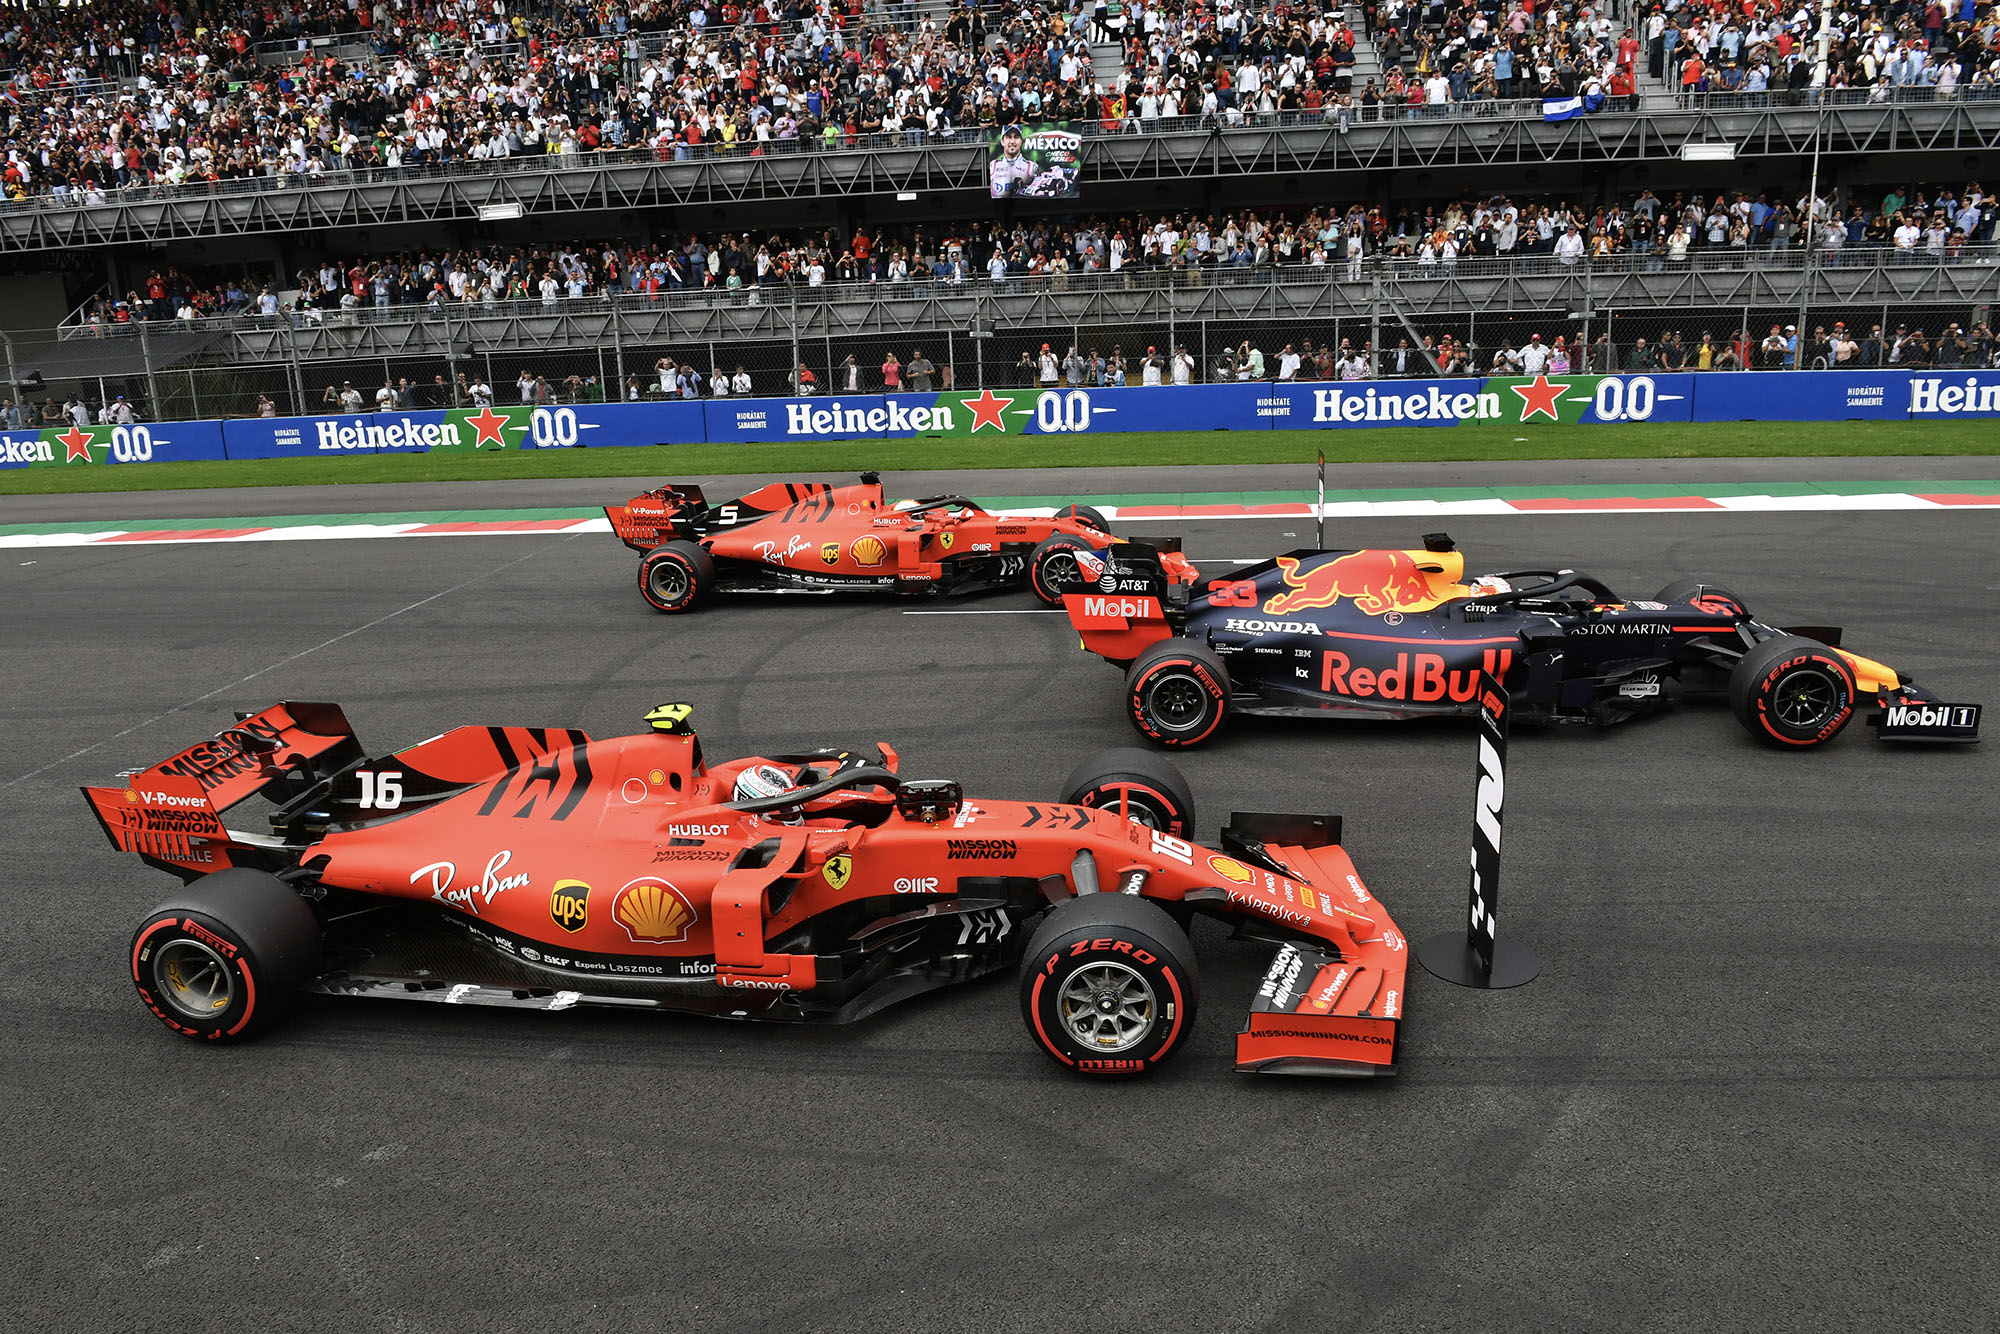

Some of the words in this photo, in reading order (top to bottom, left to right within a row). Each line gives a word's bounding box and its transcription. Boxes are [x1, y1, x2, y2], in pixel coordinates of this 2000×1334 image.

[1045, 150, 1070, 158] CHECO
[1312, 386, 1503, 423] Heineken
[786, 401, 956, 436] Heineken
[315, 417, 462, 451] Heineken
[632, 507, 666, 516] V-Power
[718, 505, 739, 525] 5
[873, 517, 903, 526] HUBLOT
[633, 537, 661, 546] MAHLE
[822, 548, 839, 563] ups
[877, 577, 895, 585] infor
[901, 573, 932, 581] Lenovo
[1118, 579, 1150, 592] AT&T
[1208, 579, 1258, 608] 33
[1084, 597, 1150, 618] Mobil
[1225, 618, 1322, 636] HONDA
[1620, 623, 1671, 635] MARTIN
[1254, 647, 1283, 655] SIEMENS
[1294, 648, 1312, 658] IBM
[1321, 649, 1409, 700] Red
[1761, 655, 1808, 694] ZERO
[1886, 706, 1950, 727] Mobil
[140, 791, 208, 808] V-Power
[355, 772, 403, 811] 16
[145, 809, 219, 823] MISSION
[147, 821, 219, 835] WINNOW
[669, 823, 731, 836] HUBLOT
[946, 839, 1018, 851] MISSION
[1149, 827, 1194, 867] 16
[656, 850, 731, 859] MISSION
[947, 849, 1018, 860] WINNOW
[409, 849, 532, 915] Ray-Ban
[552, 894, 588, 927] ups
[1226, 889, 1304, 923] KASPERSKY
[181, 917, 240, 960] PIRELLI
[543, 954, 571, 967] SKF
[574, 960, 607, 970] Experis
[1045, 952, 1060, 976] P
[1069, 938, 1158, 966] ZERO
[680, 960, 717, 975] infor
[1258, 942, 1298, 999] MISSION
[722, 976, 791, 991] Lenovo
[1271, 954, 1306, 1011] WINNOW
[1250, 1030, 1393, 1047] MISSIONWINNOW.COM
[1077, 1059, 1145, 1075] PIRELLI
